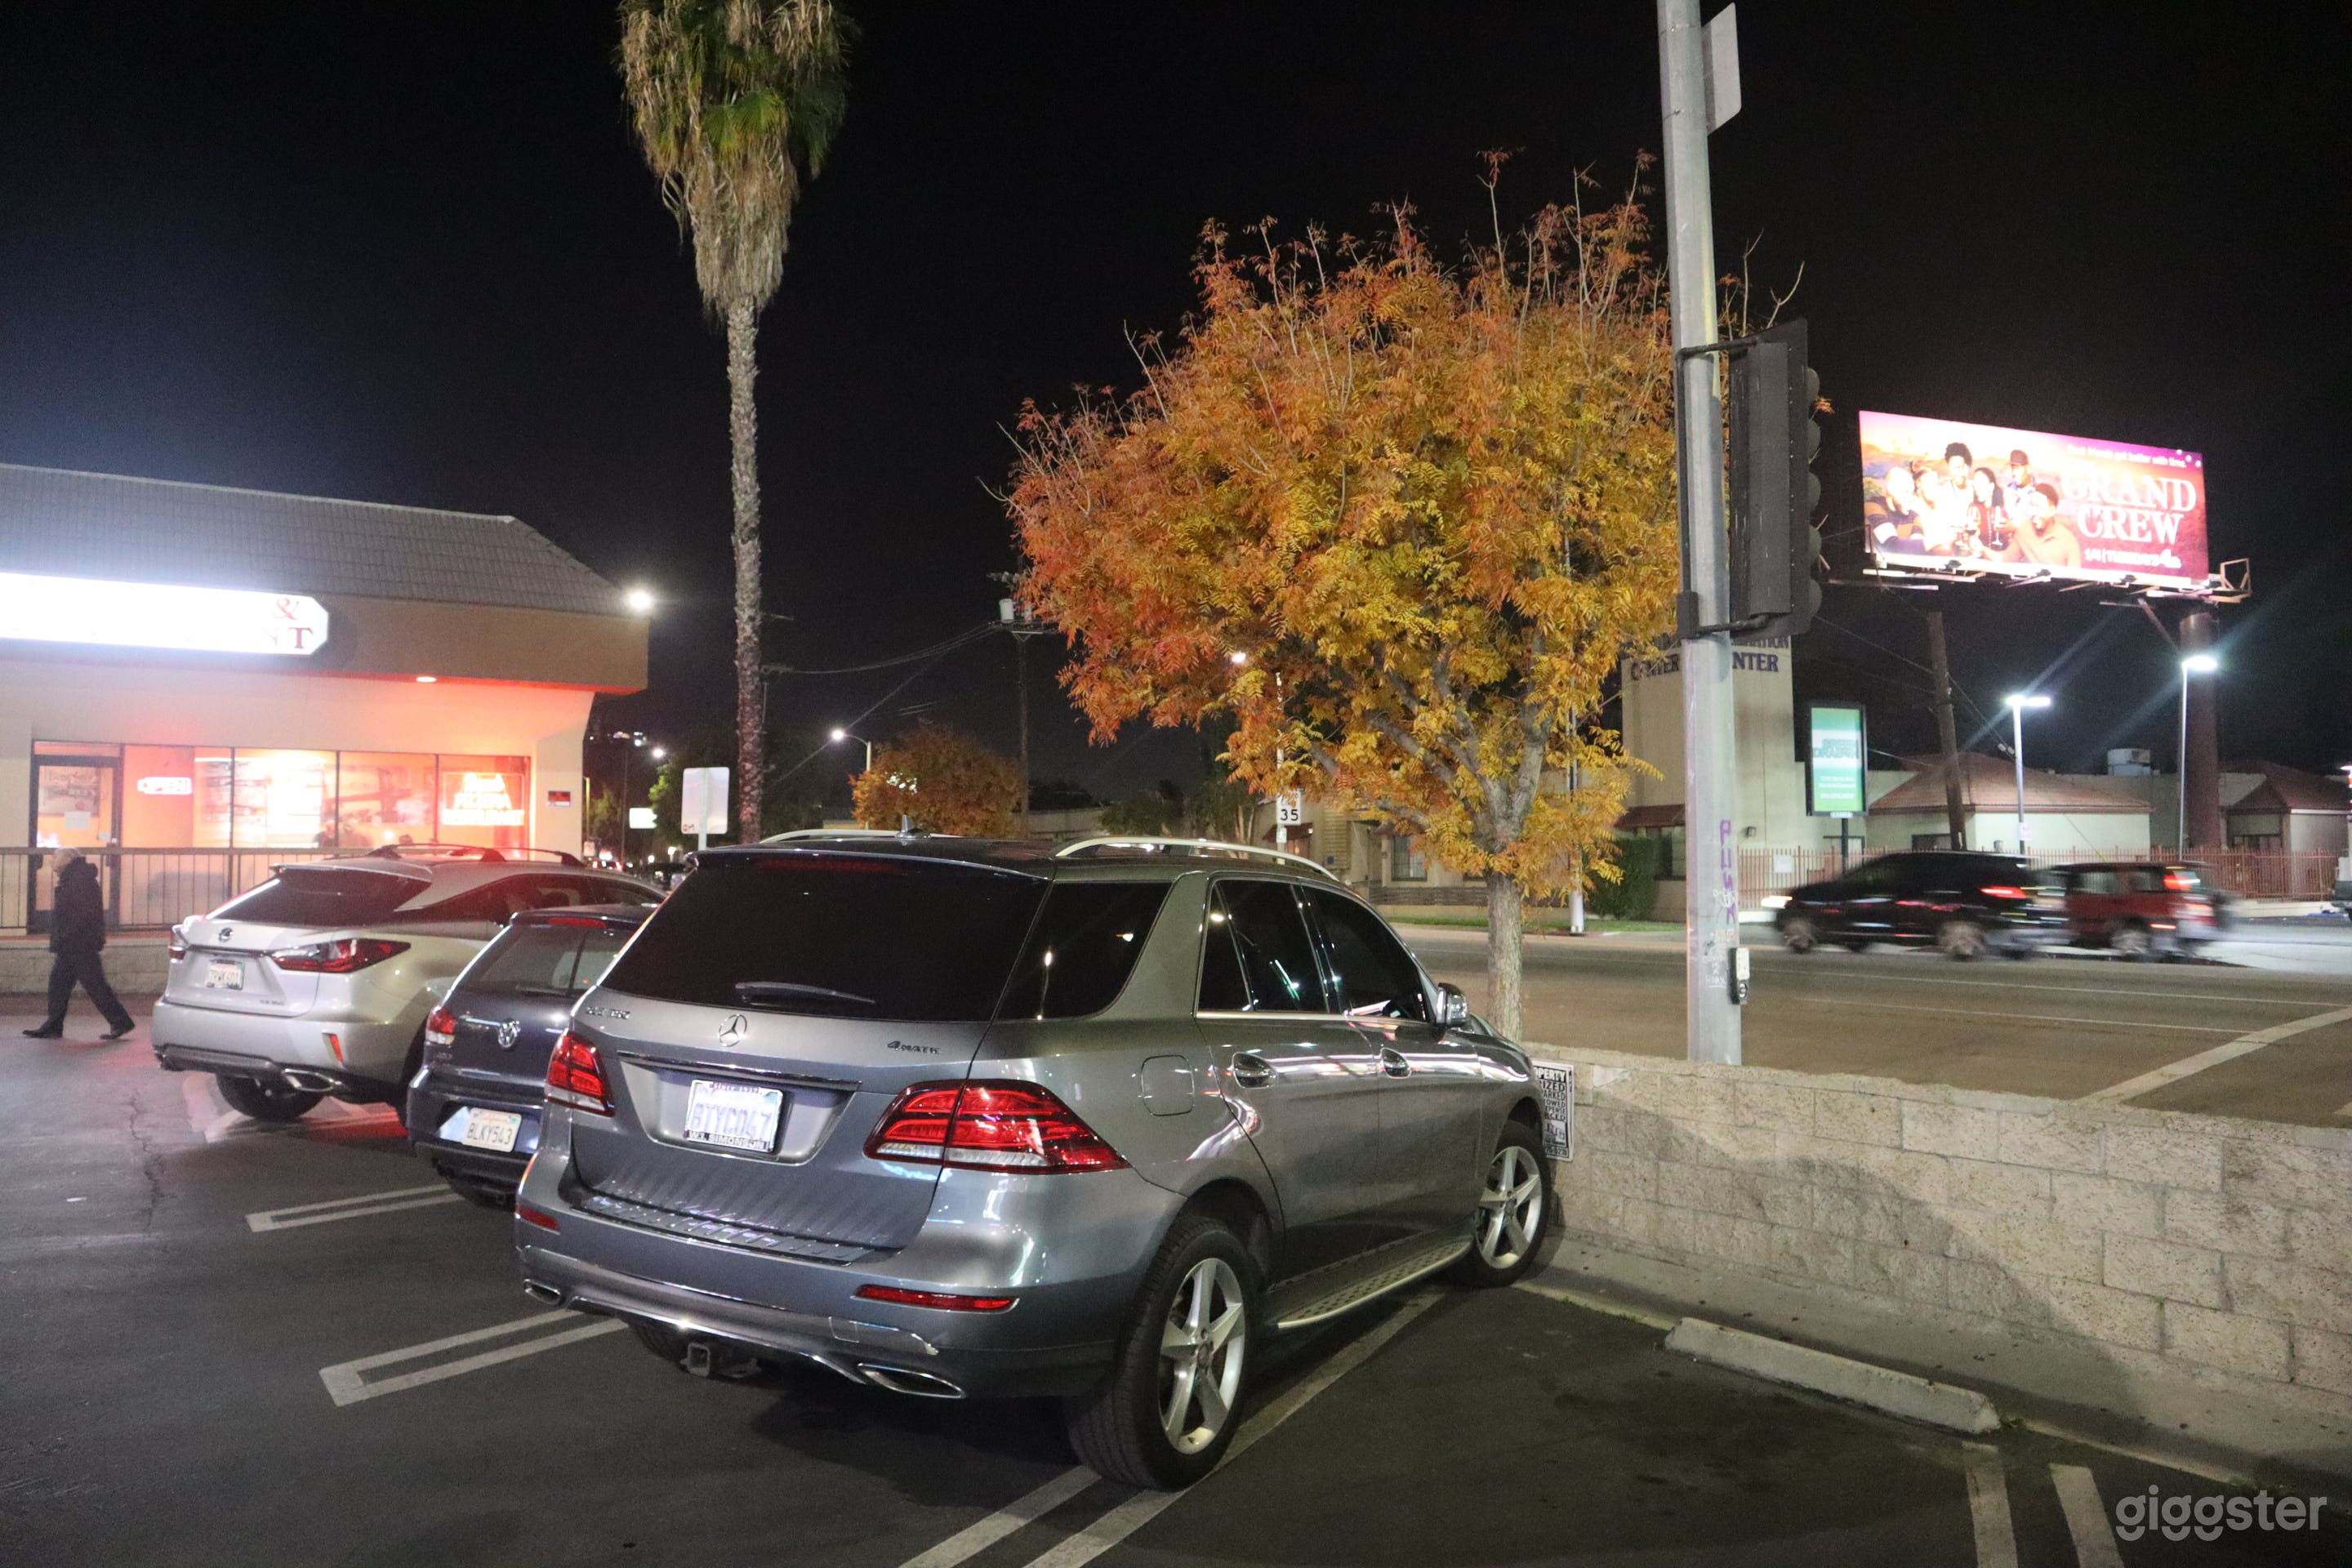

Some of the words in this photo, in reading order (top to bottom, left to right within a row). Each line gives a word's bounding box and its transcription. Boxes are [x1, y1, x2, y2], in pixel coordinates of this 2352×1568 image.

[2152, 456, 2168, 466] with
[2061, 463, 2197, 512] GRAND
[2078, 504, 2185, 545] CREW
[1732, 652, 1780, 672] NTER
[1280, 808, 1299, 822] 35
[1542, 1089, 1566, 1101] ARKED
